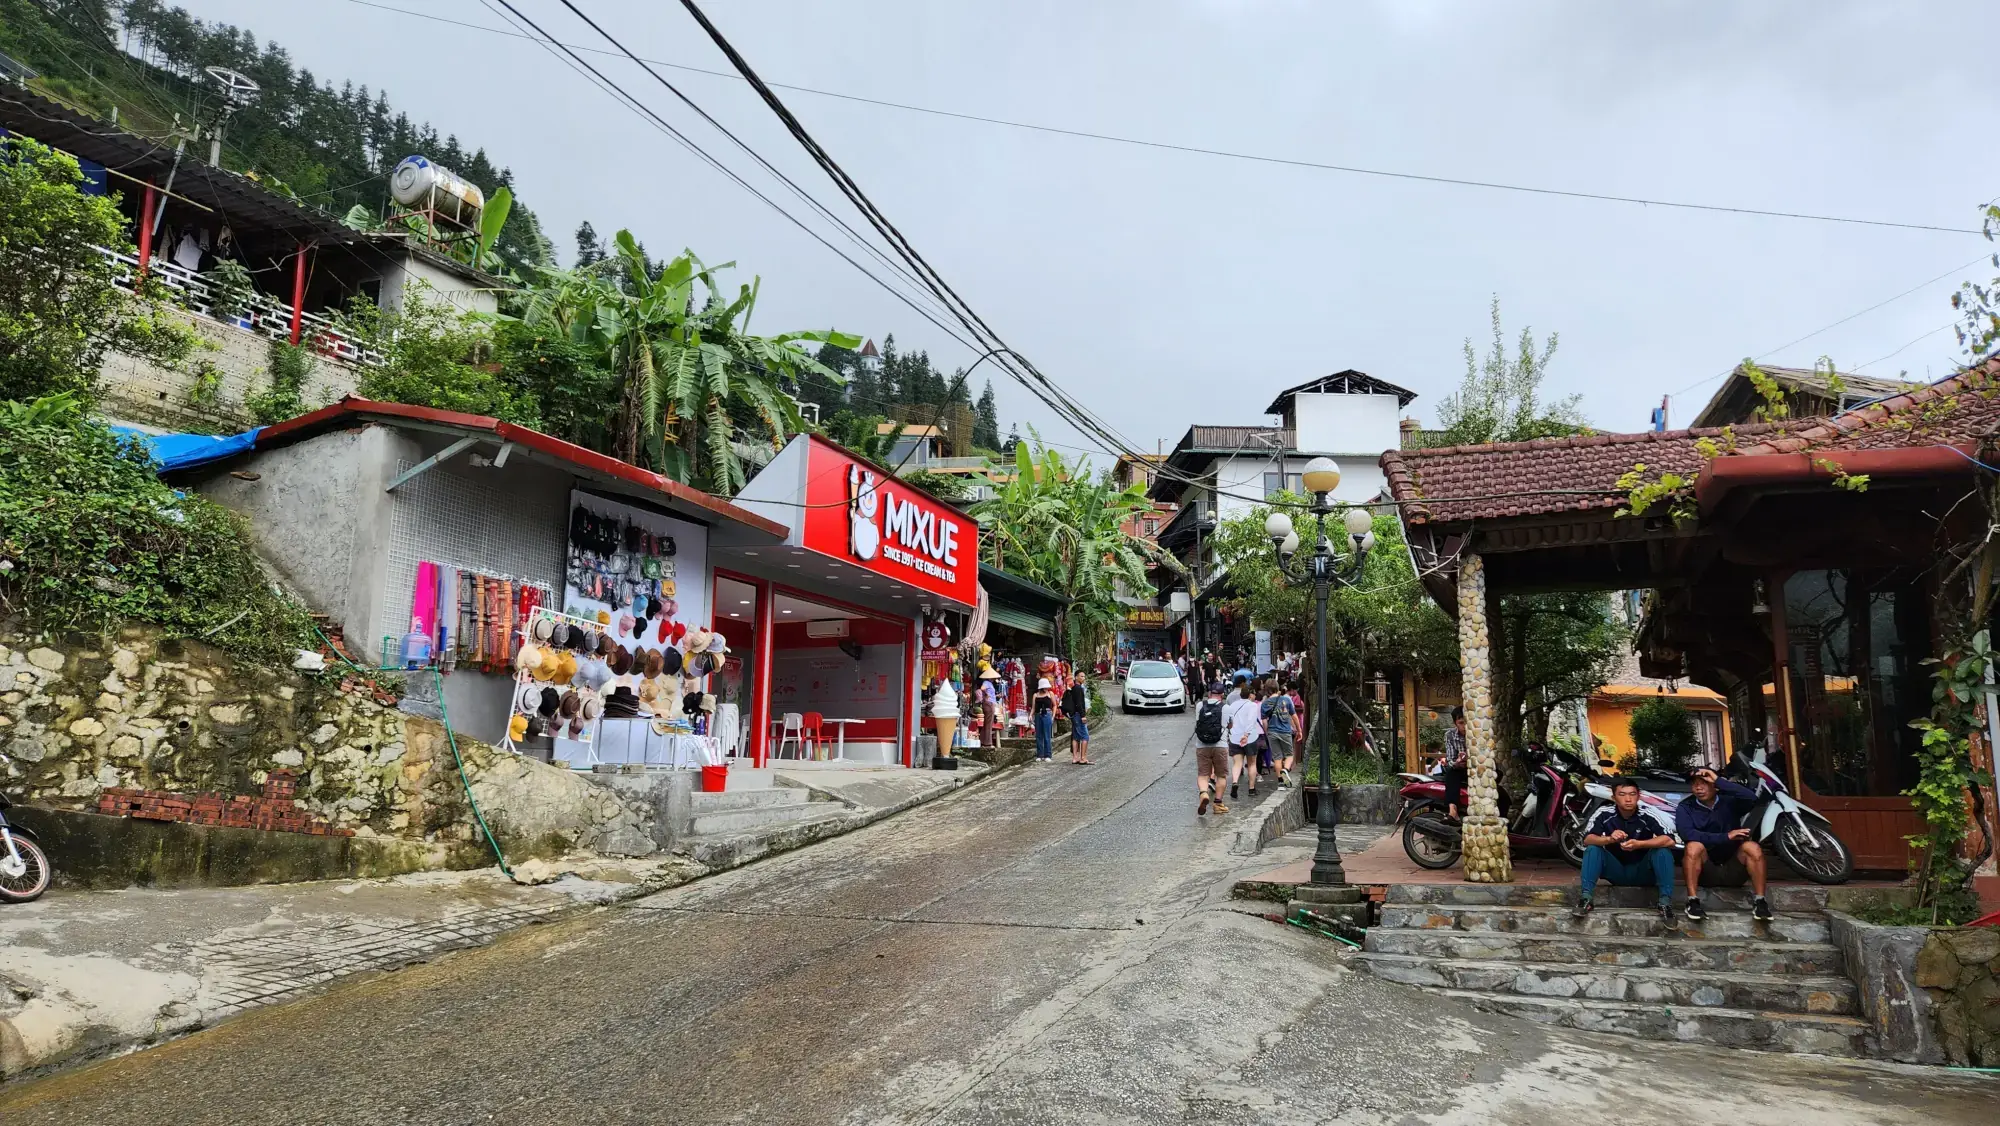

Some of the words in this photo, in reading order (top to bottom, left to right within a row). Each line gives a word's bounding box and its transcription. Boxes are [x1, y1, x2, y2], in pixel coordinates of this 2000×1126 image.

[886, 492, 958, 567] MIXUE
[884, 546, 901, 563] SINCE
[924, 561, 942, 578] CREAM
[946, 569, 956, 583] TEA
